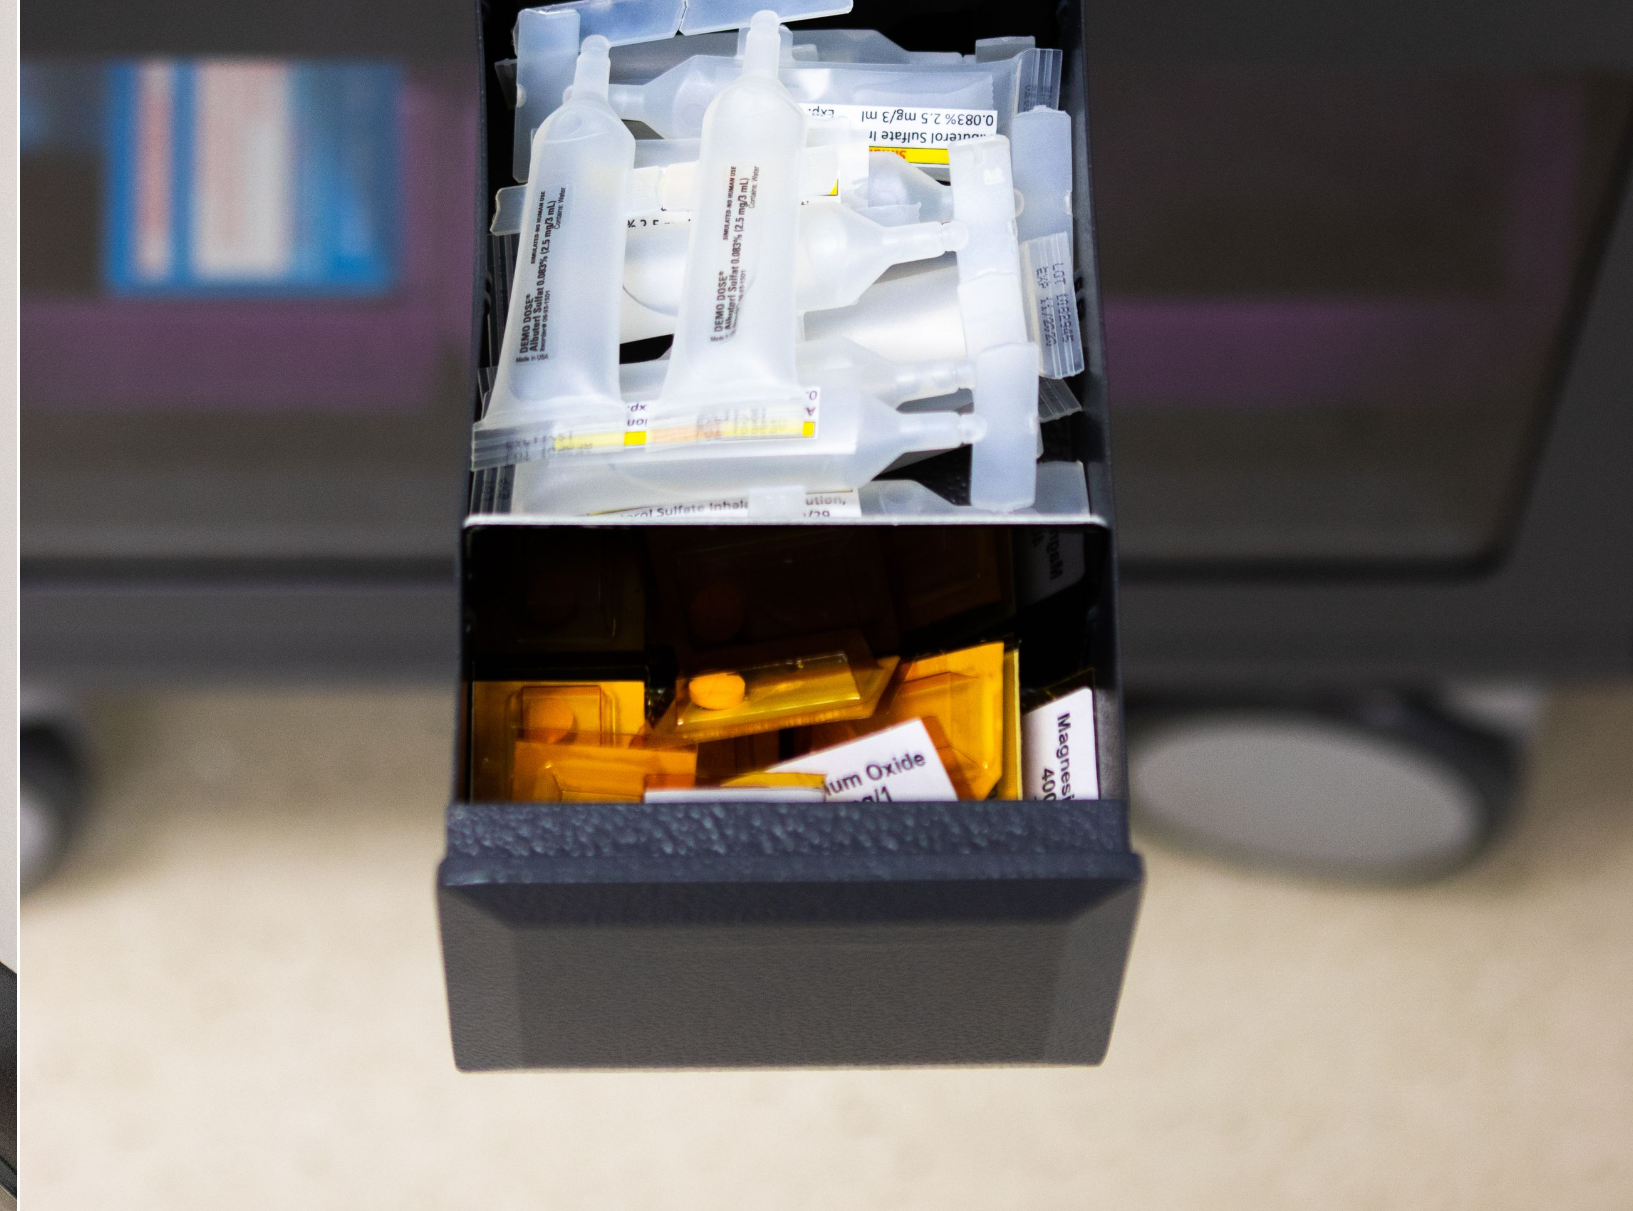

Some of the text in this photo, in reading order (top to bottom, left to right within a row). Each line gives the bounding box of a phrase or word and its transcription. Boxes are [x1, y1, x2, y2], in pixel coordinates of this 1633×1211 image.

[861, 110, 878, 122] ml
[882, 108, 916, 125] mg/3
[921, 112, 941, 125] 2.5
[945, 113, 994, 127] 0.083%
[881, 131, 927, 144] Sulfate
[752, 166, 760, 182] Water
[558, 187, 566, 203] Water
[727, 178, 735, 198] HUMAN
[740, 178, 750, 193] mL)
[536, 202, 544, 222] HUMAN
[738, 194, 748, 215] mg/3
[734, 217, 745, 233] (2.5
[731, 235, 742, 264] 0.083%
[529, 200, 557, 351] Albuterl Sulfat 0.083% (2.5 mg/3 mL)
[728, 266, 738, 292] Sulfat
[1035, 266, 1049, 288] EXP
[1052, 262, 1065, 284] LOT
[714, 304, 725, 332] DEMO
[520, 324, 531, 354] DEMO
[656, 504, 705, 517] Sulfate
[865, 750, 927, 783] Oxide
